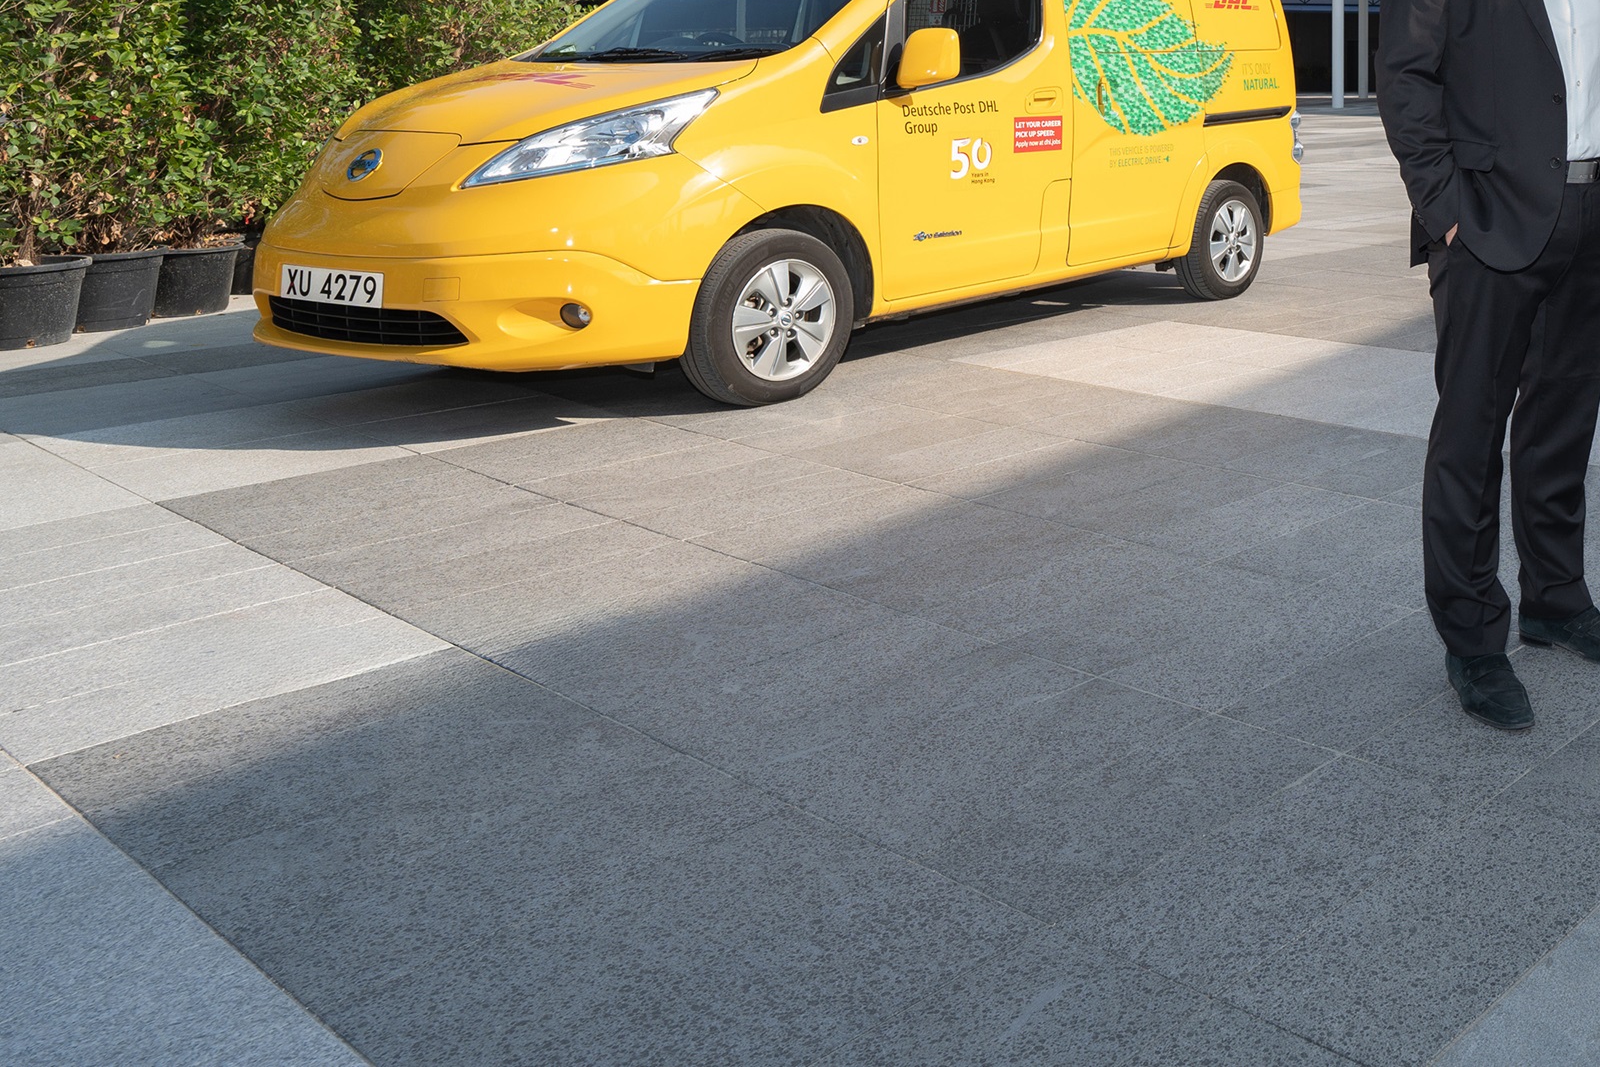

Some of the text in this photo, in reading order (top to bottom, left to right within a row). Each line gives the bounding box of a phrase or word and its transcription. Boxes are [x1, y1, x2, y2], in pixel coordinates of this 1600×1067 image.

[1255, 62, 1272, 75] ONLY
[1243, 77, 1280, 91] NATURAL.
[902, 100, 999, 117] Deutsche Post DHL
[904, 122, 938, 136] Group
[1015, 121, 1025, 129] LET
[1015, 140, 1028, 148] Apply
[950, 137, 993, 180] 50
[286, 268, 378, 304] XU 4279
